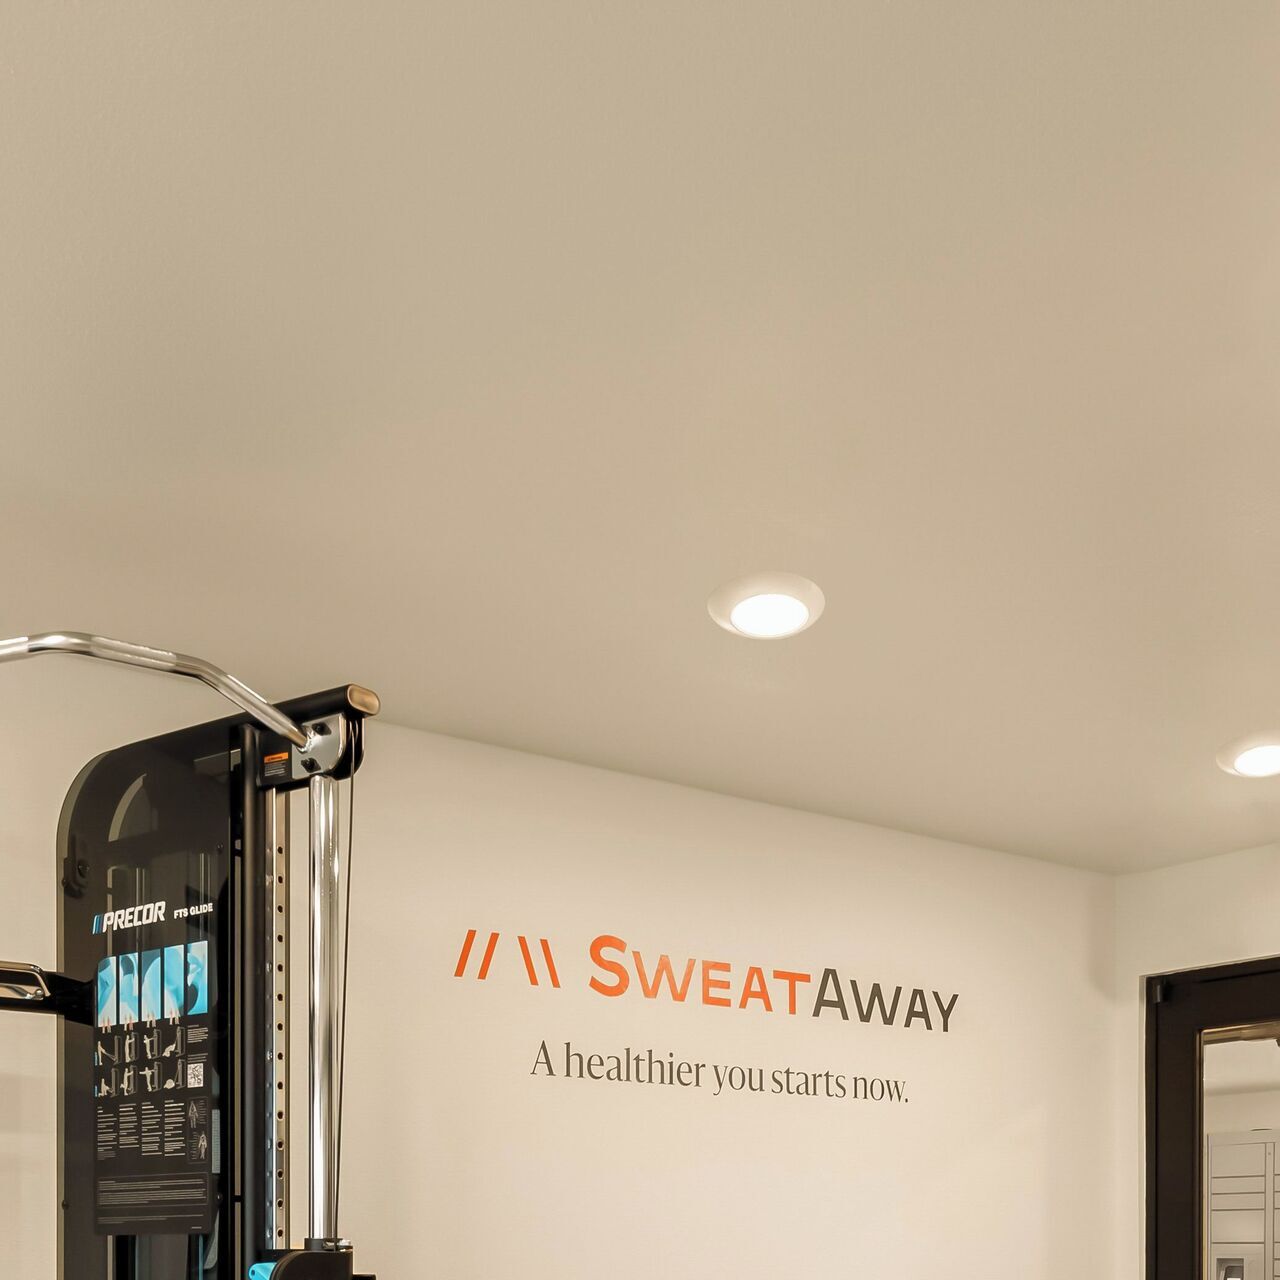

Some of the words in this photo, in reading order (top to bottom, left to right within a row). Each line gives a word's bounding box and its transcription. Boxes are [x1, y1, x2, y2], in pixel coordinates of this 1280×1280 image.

[103, 901, 166, 933] PRECOR
[174, 908, 188, 919] FTS
[190, 903, 213, 916] GLIDE
[530, 1039, 556, 1076] A
[564, 1041, 705, 1087] healthier
[712, 1063, 765, 1096] you
[771, 1065, 847, 1099] starts
[852, 1076, 909, 1103] now.
